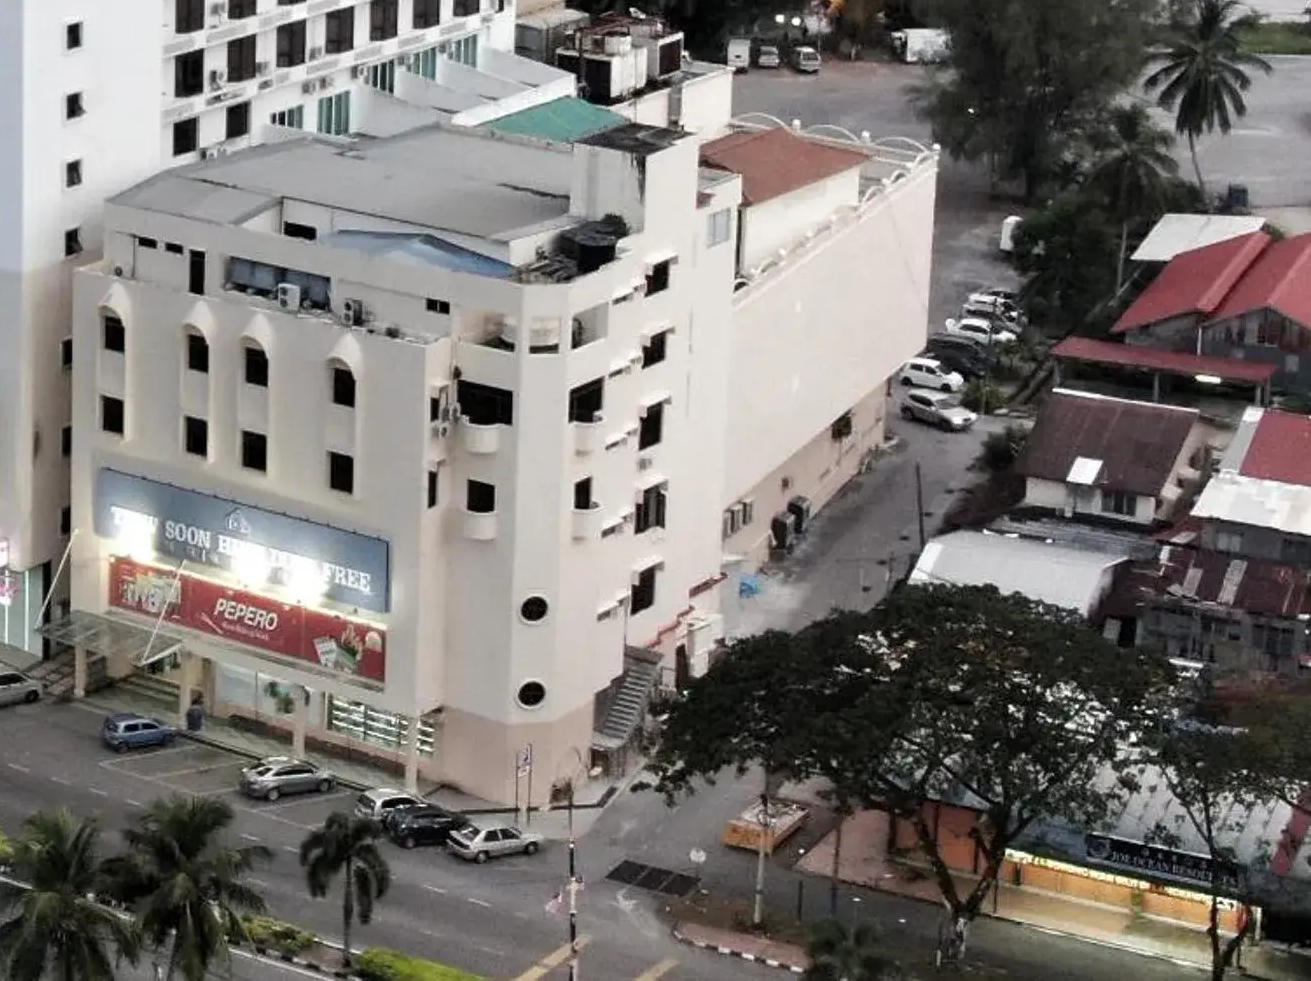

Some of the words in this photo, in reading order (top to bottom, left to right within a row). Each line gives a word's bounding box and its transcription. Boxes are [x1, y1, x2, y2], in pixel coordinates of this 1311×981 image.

[164, 520, 212, 549] SOON
[323, 563, 371, 595] FREE
[213, 597, 279, 632] PEPERO
